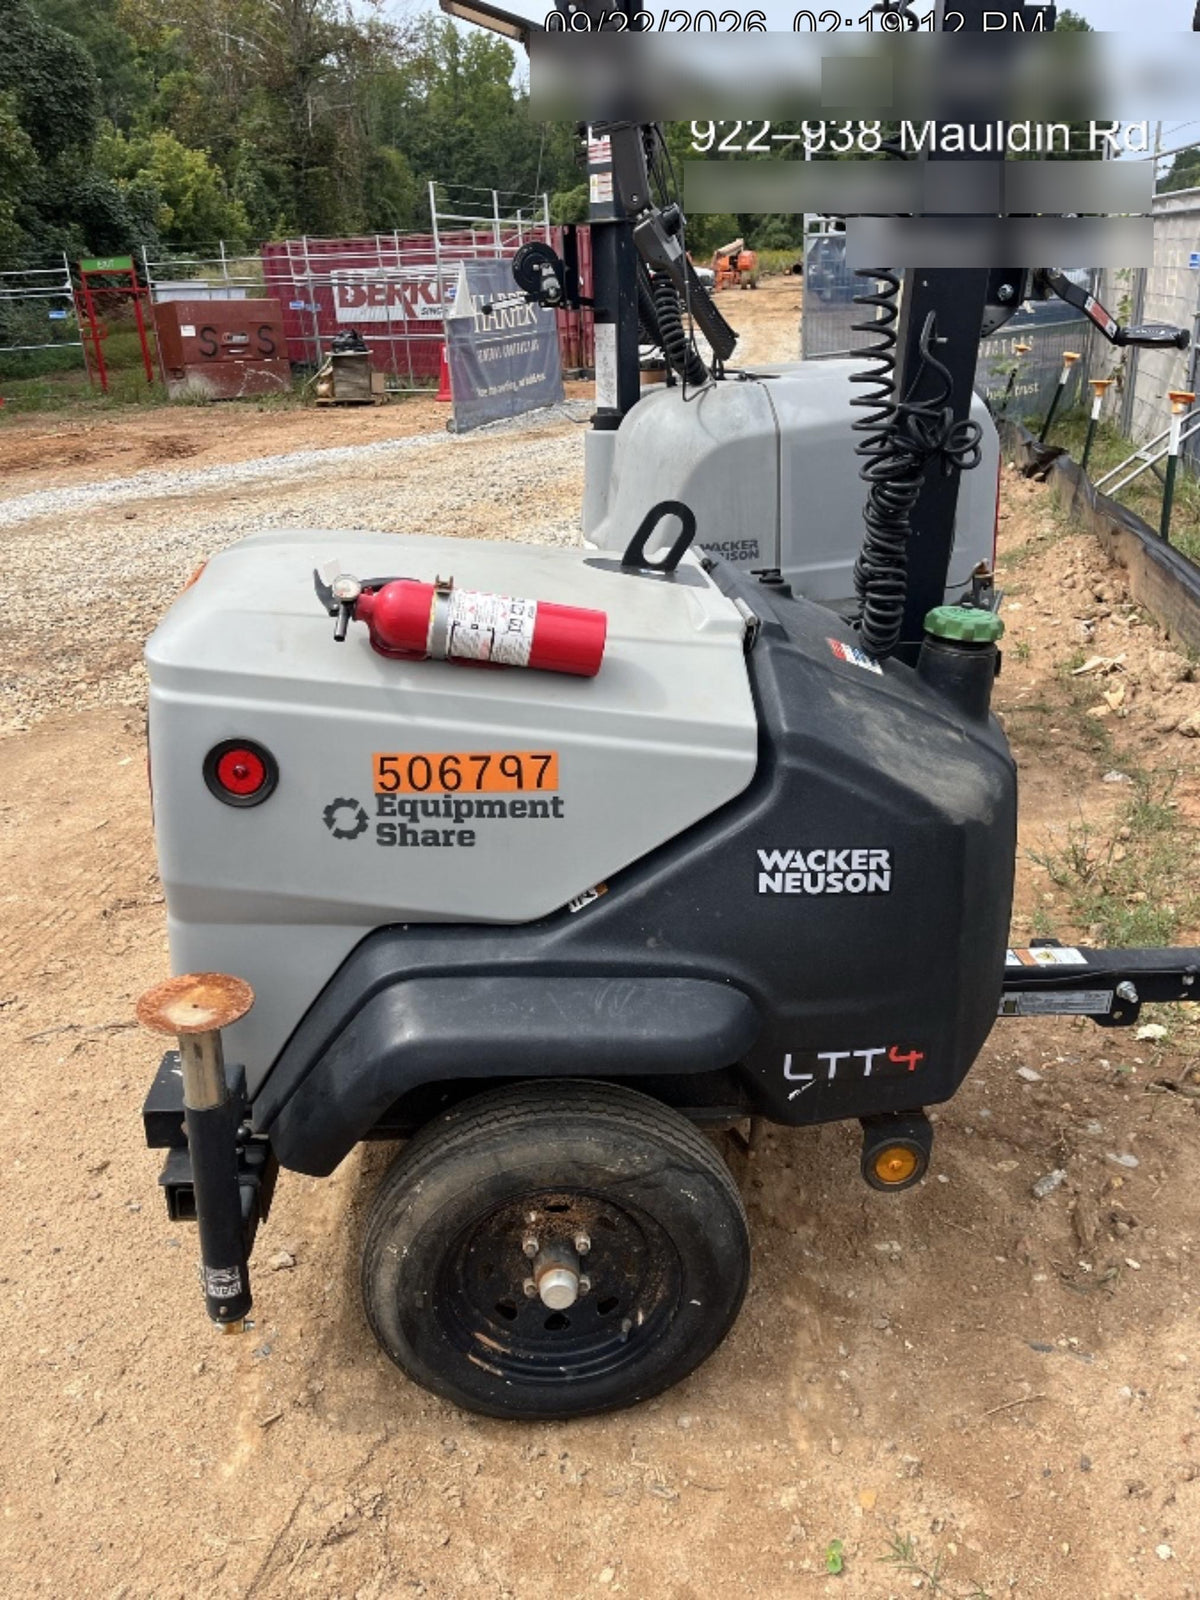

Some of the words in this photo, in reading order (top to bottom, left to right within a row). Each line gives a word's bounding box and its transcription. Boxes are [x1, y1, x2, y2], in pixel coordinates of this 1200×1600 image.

[200, 326, 219, 357] S
[257, 325, 276, 355] S
[378, 754, 552, 792] 506797
[375, 792, 565, 823] Equipment
[376, 822, 476, 847] Share
[757, 849, 892, 871] WACKER
[758, 871, 892, 894] NEUSON
[783, 1045, 925, 1081] LTT4
